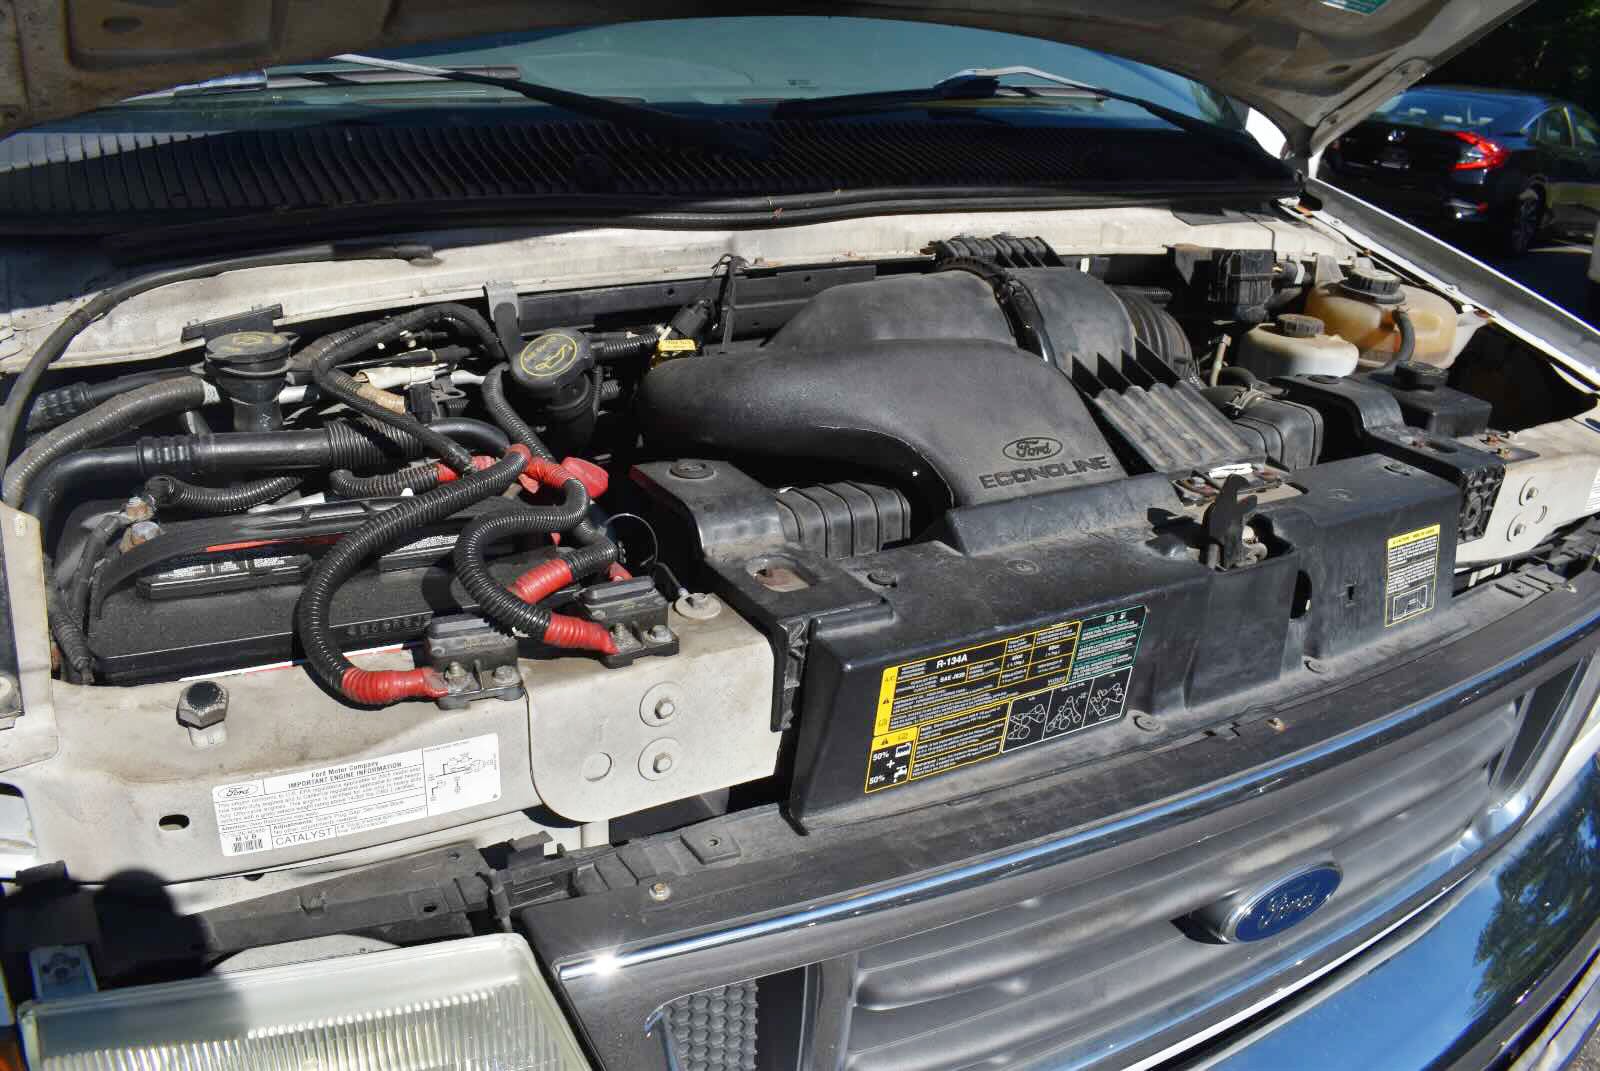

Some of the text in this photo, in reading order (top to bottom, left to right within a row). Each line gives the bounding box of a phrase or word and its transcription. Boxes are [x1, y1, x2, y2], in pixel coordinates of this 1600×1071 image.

[1016, 440, 1052, 457] Ford
[979, 455, 1111, 489] ECONOLINE
[936, 654, 968, 669] R-134A
[873, 751, 890, 761] 50%
[288, 777, 329, 789] IMPORTANT
[330, 772, 354, 782] ENGINE
[356, 762, 402, 777] INFORMATION
[328, 767, 347, 775] Motor
[869, 774, 886, 784] 50%
[226, 786, 250, 797] Ford
[275, 828, 335, 846] CATALYST
[1258, 882, 1320, 930] Ford
